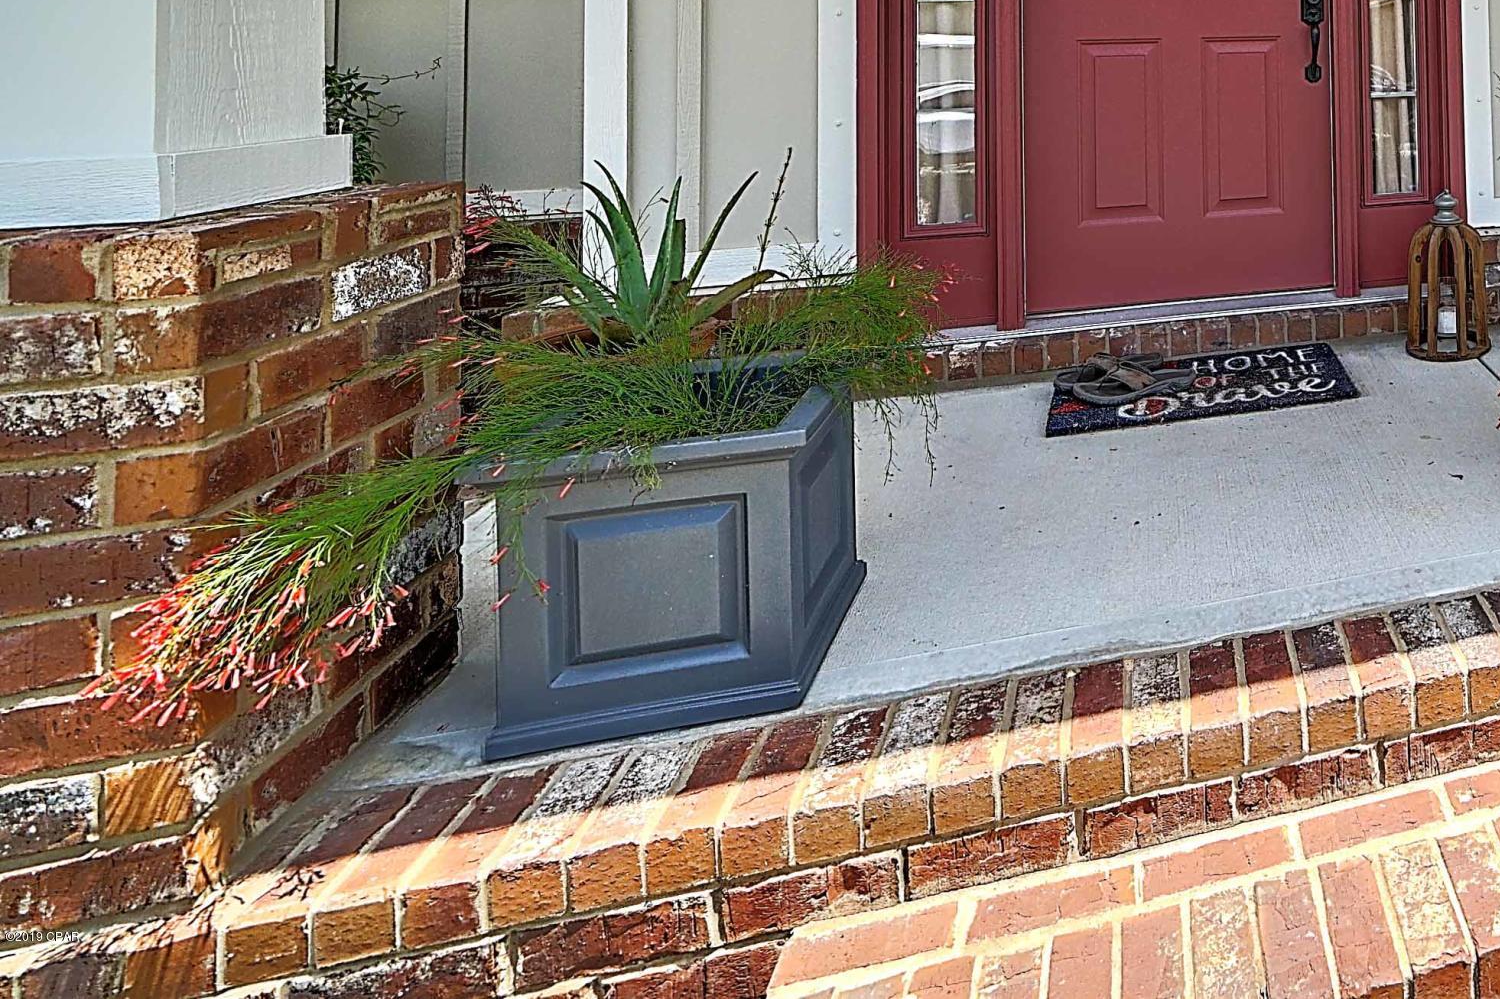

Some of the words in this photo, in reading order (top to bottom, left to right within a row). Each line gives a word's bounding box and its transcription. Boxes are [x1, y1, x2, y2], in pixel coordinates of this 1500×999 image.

[1192, 347, 1316, 374] HOME
[1193, 373, 1236, 388] OF
[1261, 362, 1325, 379] THE
